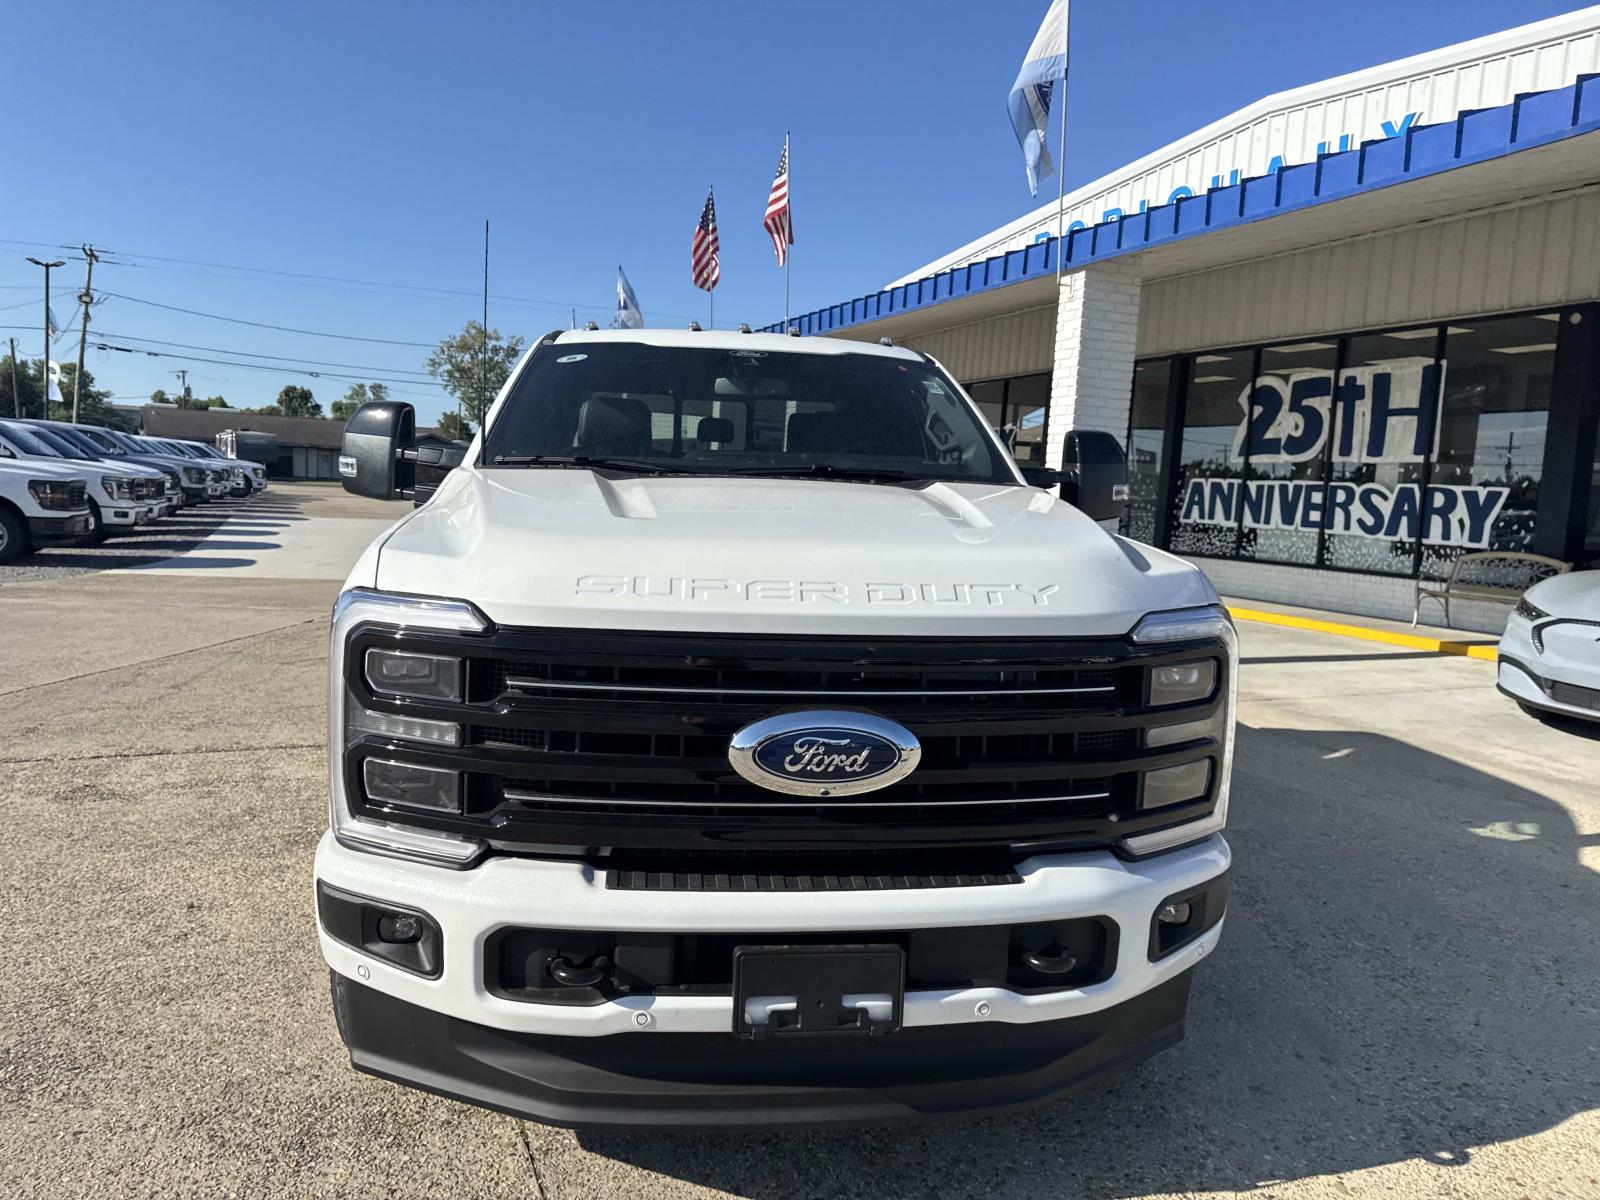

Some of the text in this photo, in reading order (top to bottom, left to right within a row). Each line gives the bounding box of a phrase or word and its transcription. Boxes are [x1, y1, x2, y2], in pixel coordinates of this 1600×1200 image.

[1183, 481, 1501, 543] ANNIVERSARY
[576, 575, 1059, 605] SUPER DUTY
[784, 736, 869, 772] Ford
